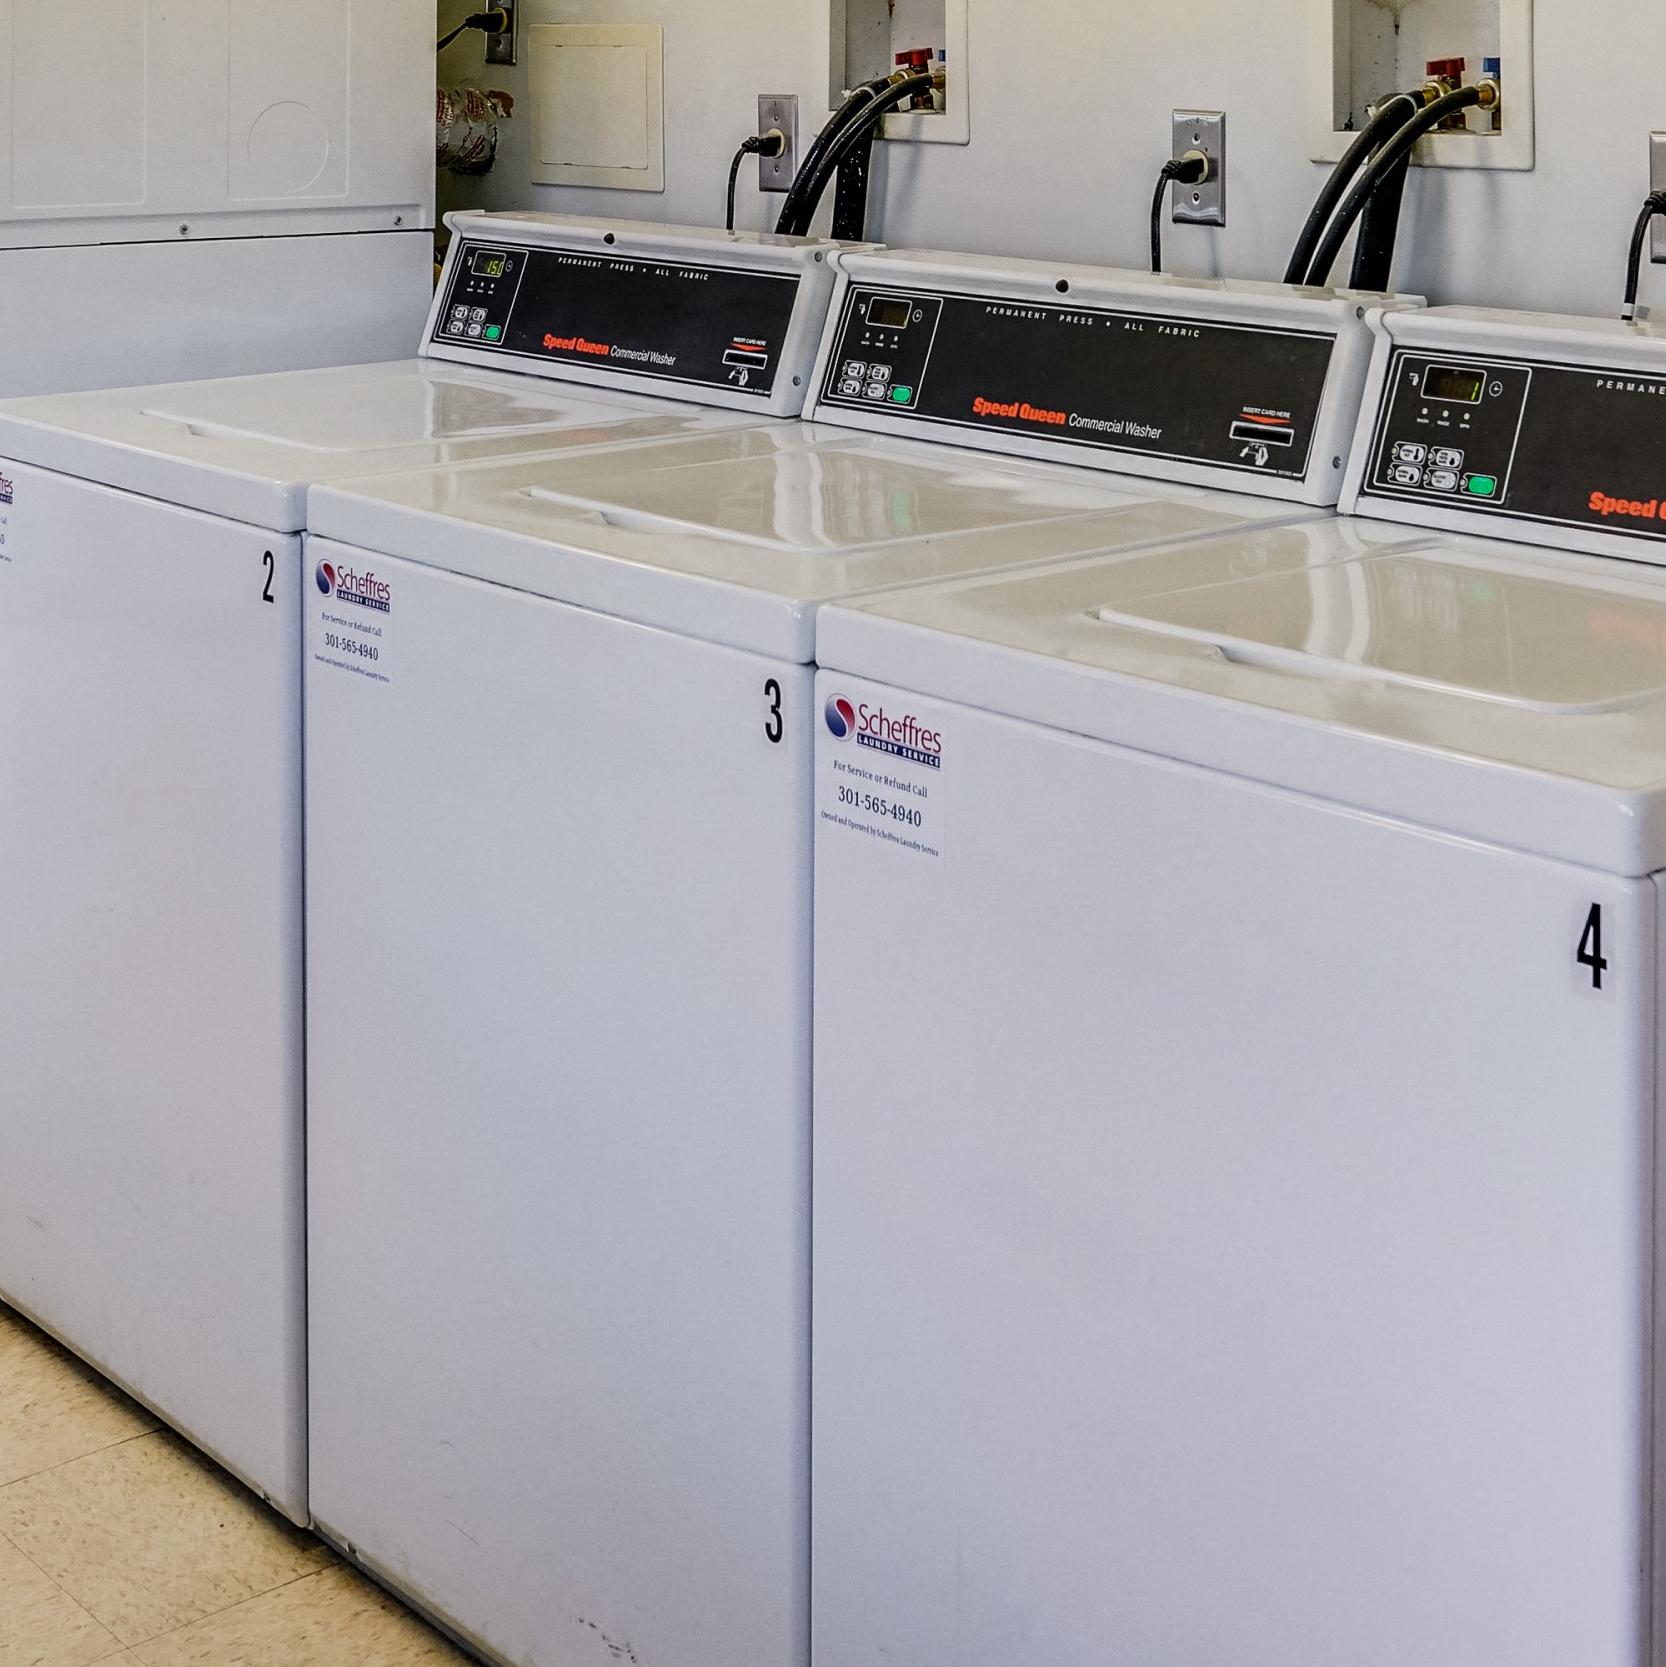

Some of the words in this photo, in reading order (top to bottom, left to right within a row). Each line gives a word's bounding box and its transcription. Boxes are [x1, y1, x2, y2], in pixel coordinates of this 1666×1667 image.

[557, 257, 602, 268] PERMANENT
[608, 262, 634, 272] PRESS
[654, 267, 670, 276] ALL
[678, 270, 709, 280] FABRIC
[984, 306, 1047, 320] PERMANENT
[1058, 314, 1093, 325] PRESS
[1123, 321, 1145, 331] ALL
[1157, 325, 1200, 337] FABRIC
[541, 333, 576, 353] Speed
[574, 338, 610, 356] Queen
[609, 343, 650, 363] Commercial
[648, 349, 677, 367] Washer
[1470, 382, 1480, 401] 1
[971, 397, 1019, 421] Speed
[1017, 403, 1067, 426] Queen
[1067, 411, 1124, 434] Commercial
[1123, 419, 1163, 440] Washer
[1241, 406, 1261, 415] INSERT
[1260, 408, 1276, 417] CARD
[1275, 410, 1291, 419] HERE
[1586, 491, 1657, 523] Speed
[263, 550, 274, 603] 2
[336, 563, 390, 601] Scheffres
[337, 590, 362, 603] LAUNDRY
[365, 597, 388, 610] SERVICE
[324, 632, 378, 660] 301-565-4940
[764, 678, 783, 743] 3
[857, 701, 941, 754] Scheffres
[858, 734, 898, 754] LAUNDRY
[902, 747, 938, 766] SERVICE
[833, 759, 845, 772] For
[847, 763, 872, 780] Service
[874, 774, 882, 783] or
[883, 774, 910, 792] Refund
[912, 783, 927, 798] Call
[838, 785, 921, 828] 301-565-4940
[1577, 902, 1607, 990] 4
